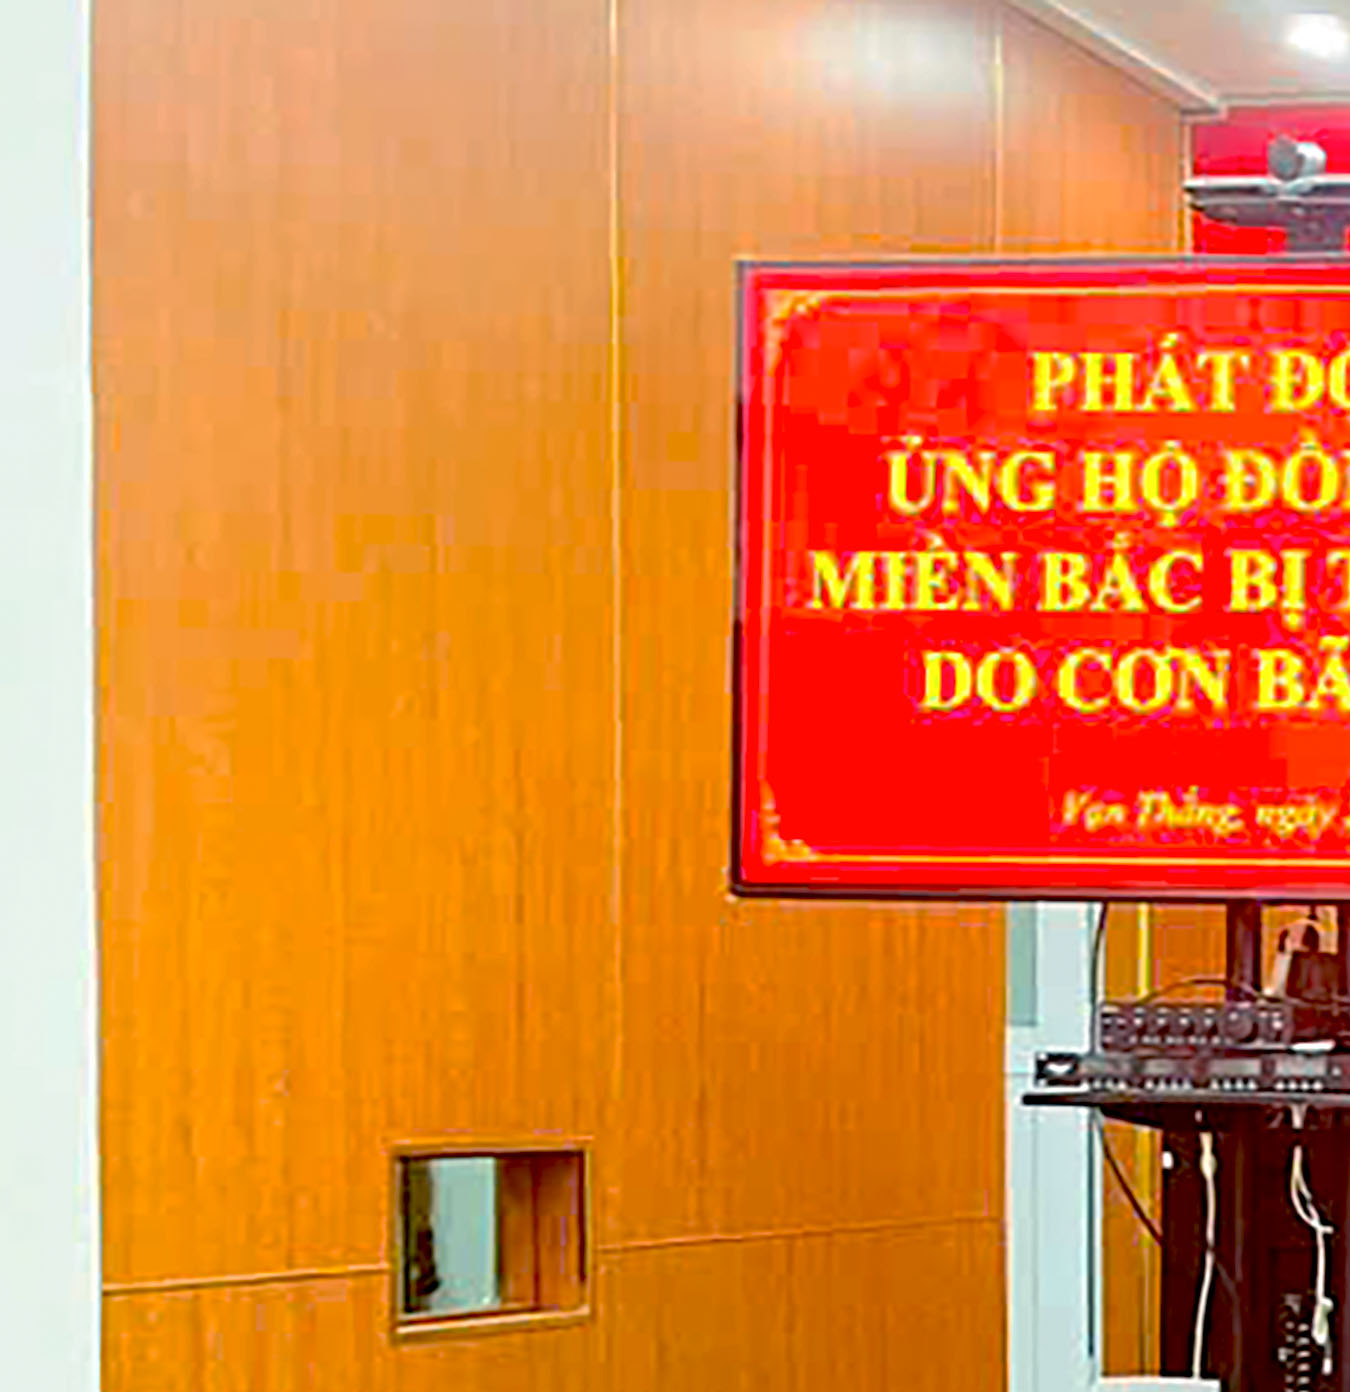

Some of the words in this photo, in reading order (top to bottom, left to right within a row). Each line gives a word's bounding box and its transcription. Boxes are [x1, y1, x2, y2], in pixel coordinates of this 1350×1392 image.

[1031, 332, 1250, 413] PHÁT
[883, 434, 1057, 516] ỦNG
[1079, 439, 1199, 527] HỘ
[808, 531, 1018, 612] MIỀN
[1038, 531, 1204, 613] BẮC
[1226, 548, 1311, 629] BỊ
[921, 648, 1038, 712] DO
[1056, 646, 1231, 713] CƠN
